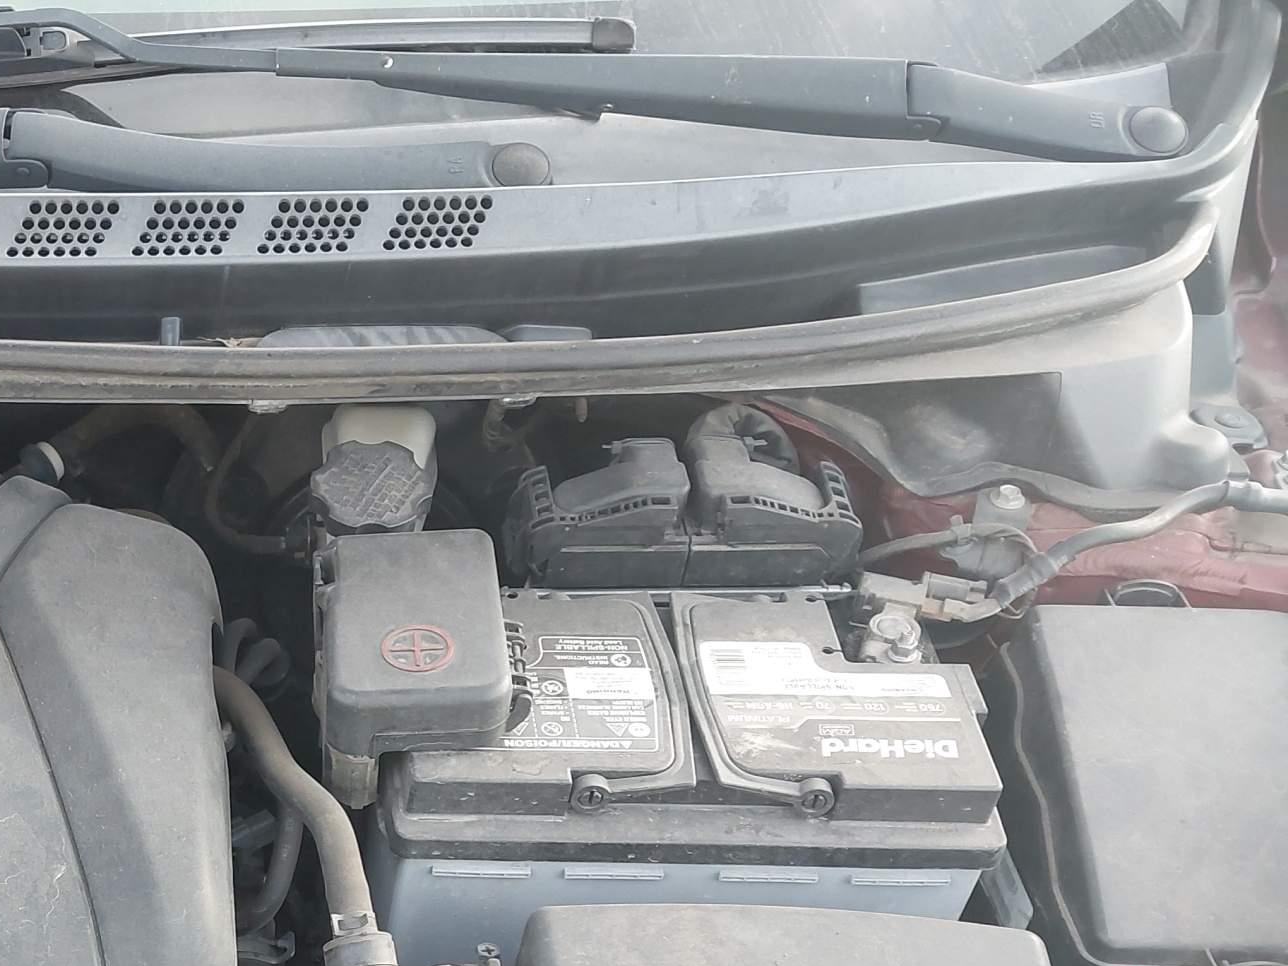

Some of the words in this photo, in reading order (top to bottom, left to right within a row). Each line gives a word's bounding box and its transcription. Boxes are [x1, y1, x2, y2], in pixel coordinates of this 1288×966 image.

[727, 714, 791, 723] PLATINUM
[503, 739, 621, 749] DANGER/POISON
[821, 738, 959, 759] DieHard
